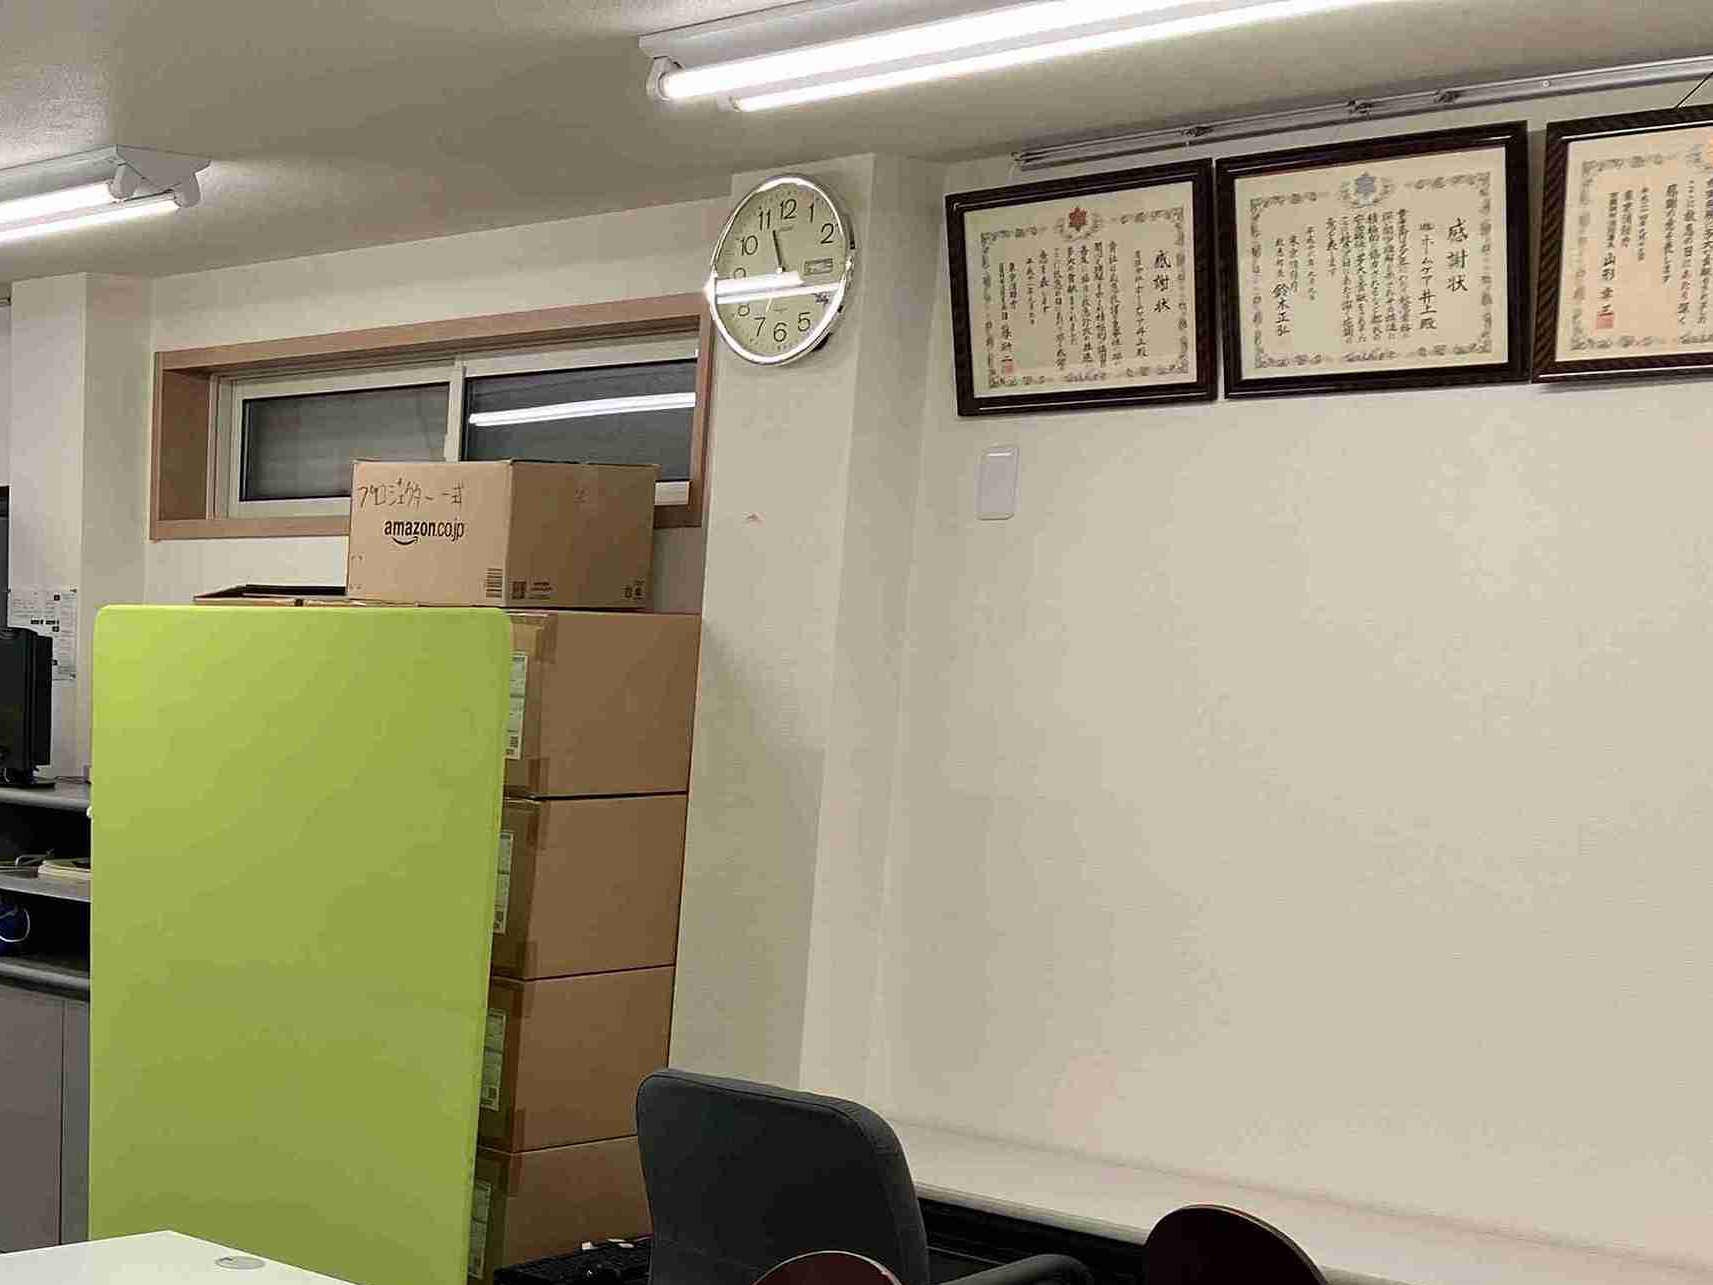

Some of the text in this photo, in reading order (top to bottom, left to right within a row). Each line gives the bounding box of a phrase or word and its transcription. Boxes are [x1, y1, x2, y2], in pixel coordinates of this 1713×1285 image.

[758, 209, 772, 231] 11
[779, 198, 797, 220] 12
[807, 202, 815, 223] 1
[820, 223, 835, 245] 2
[739, 235, 759, 257] 10
[1445, 216, 1470, 293] 感謝状
[1152, 249, 1173, 313] 感謝状
[754, 317, 767, 337] 7
[773, 322, 788, 343] 6
[797, 312, 812, 332] 5
[384, 518, 465, 542] amazon.co.jp
